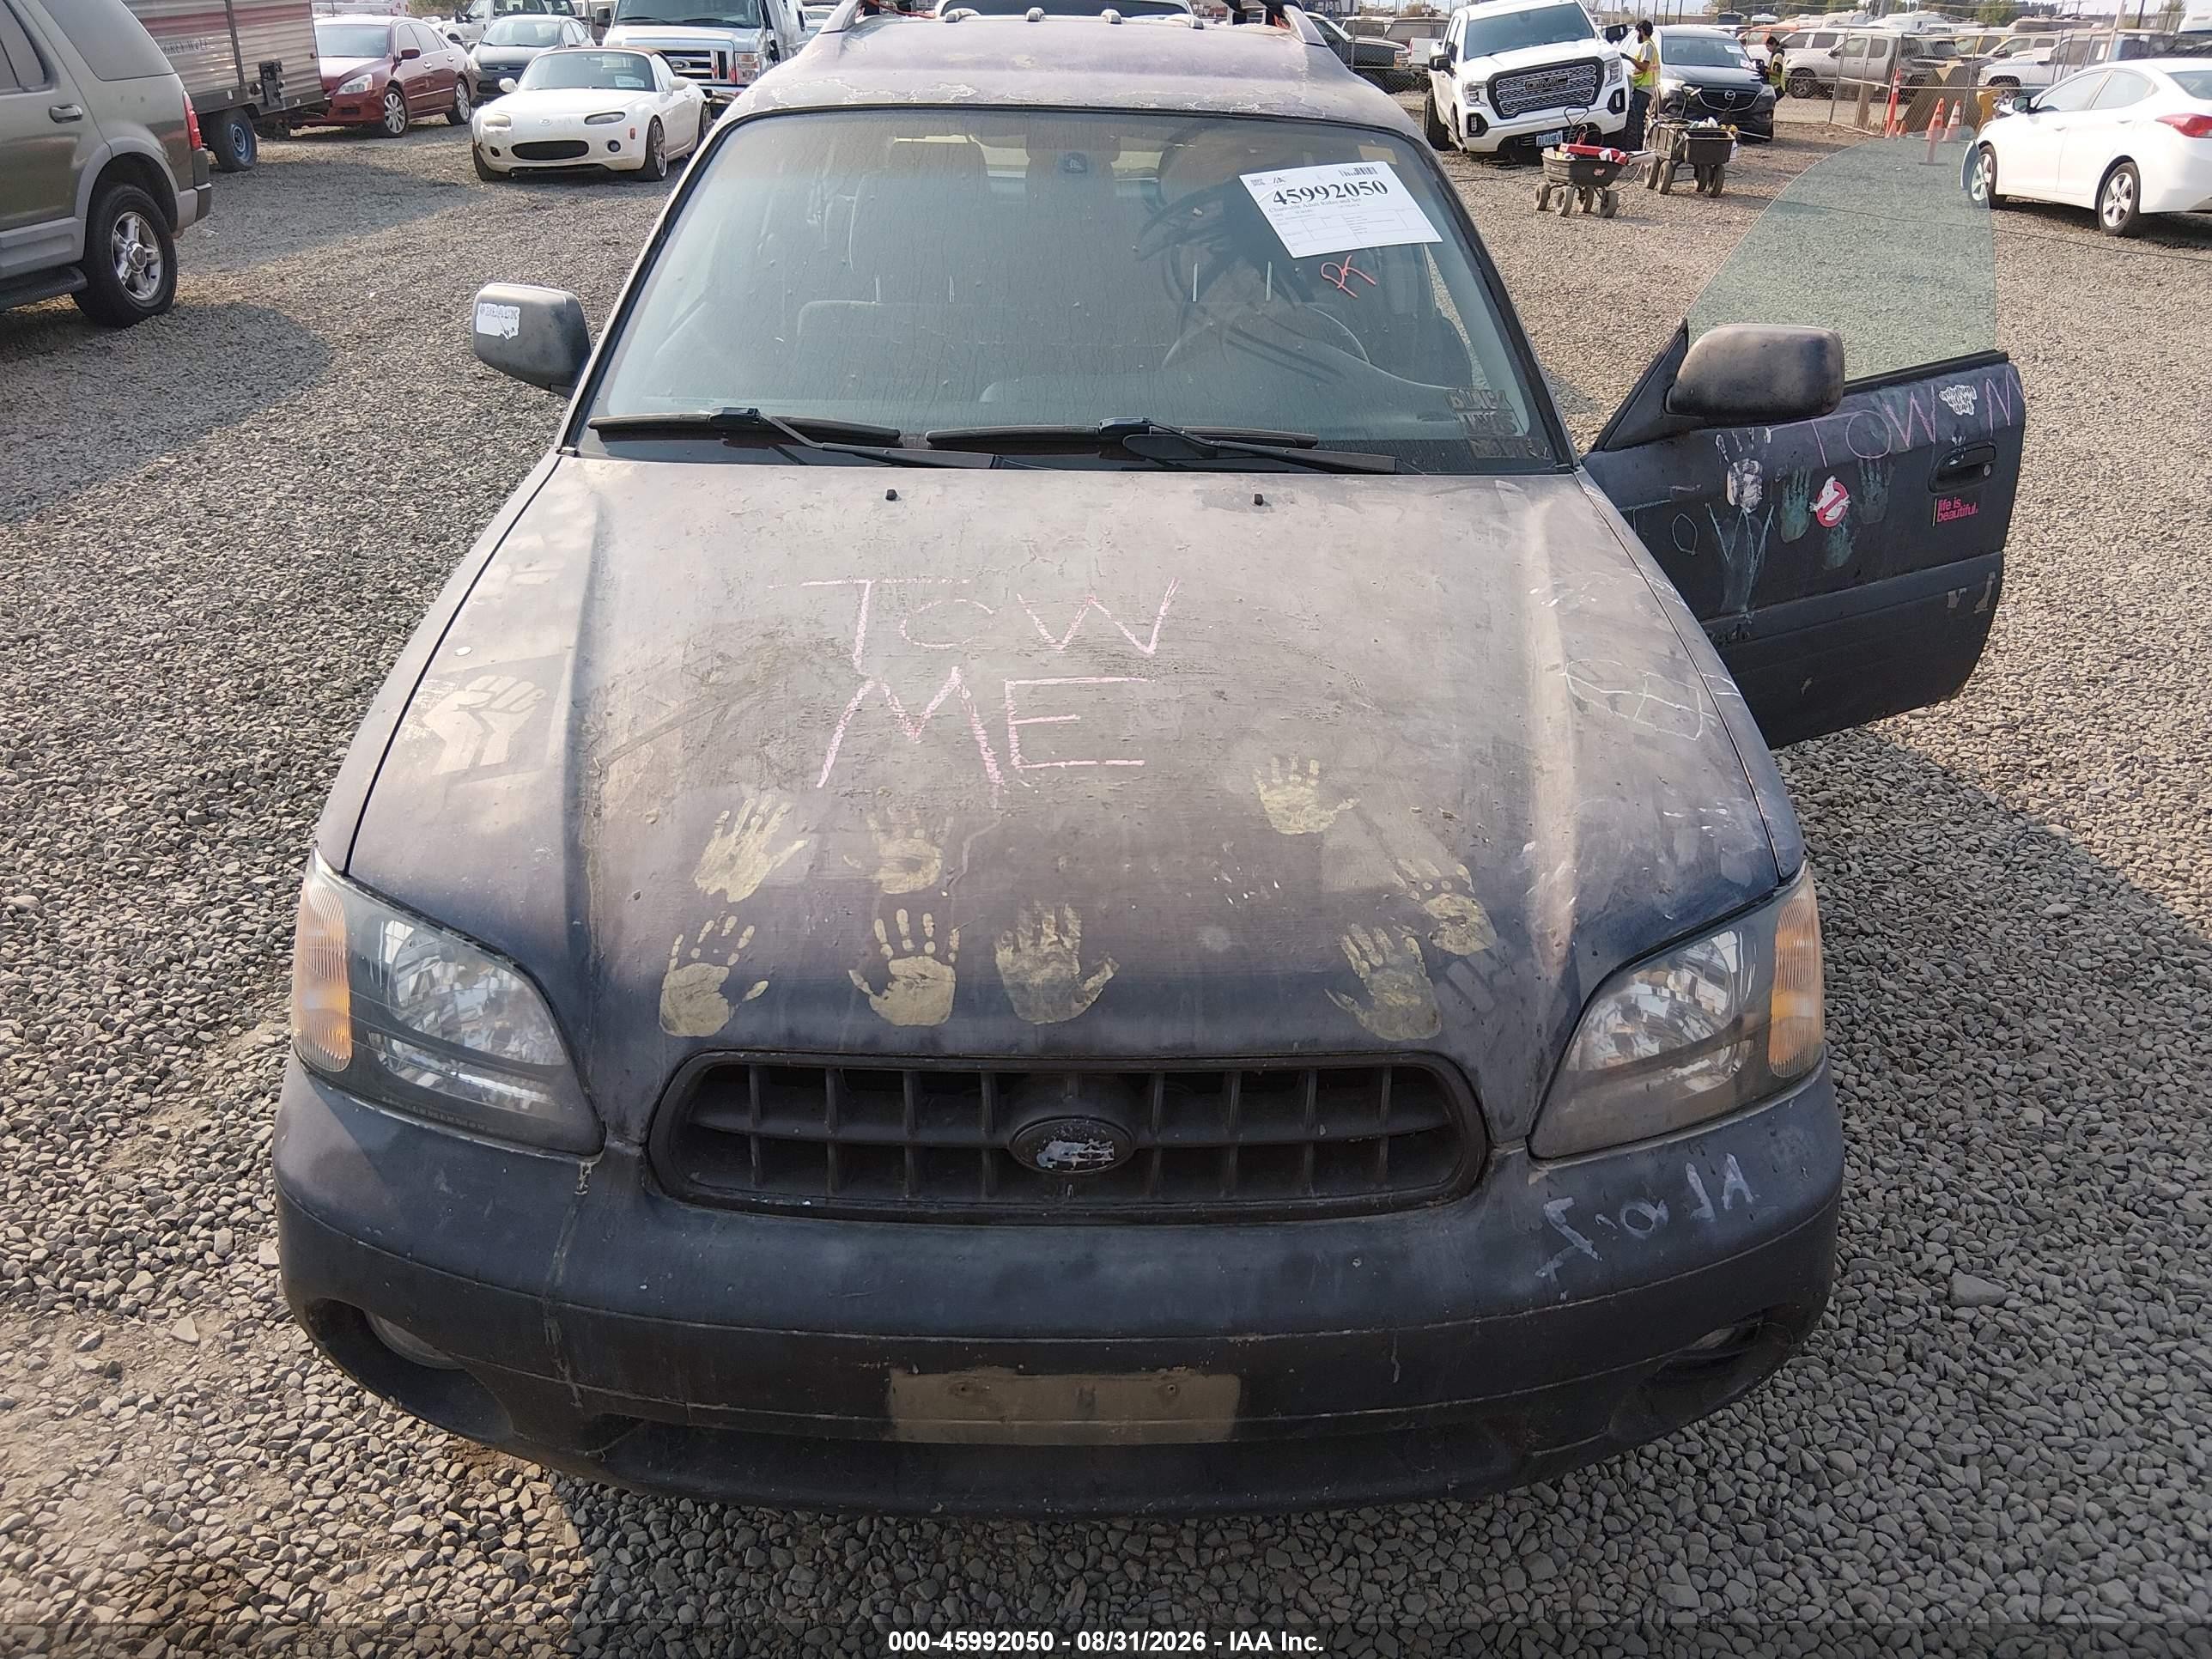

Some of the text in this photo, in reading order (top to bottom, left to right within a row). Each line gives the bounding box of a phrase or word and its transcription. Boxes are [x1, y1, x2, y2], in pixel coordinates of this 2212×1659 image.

[1525, 75, 1568, 90] GMC
[1273, 179, 1389, 205] 45992050
[1769, 386, 1937, 467] TOW
[1936, 502, 1978, 523] beautiful.
[1938, 496, 1962, 513] life is
[800, 577, 1180, 675] TOW
[816, 666, 1156, 792] ME
